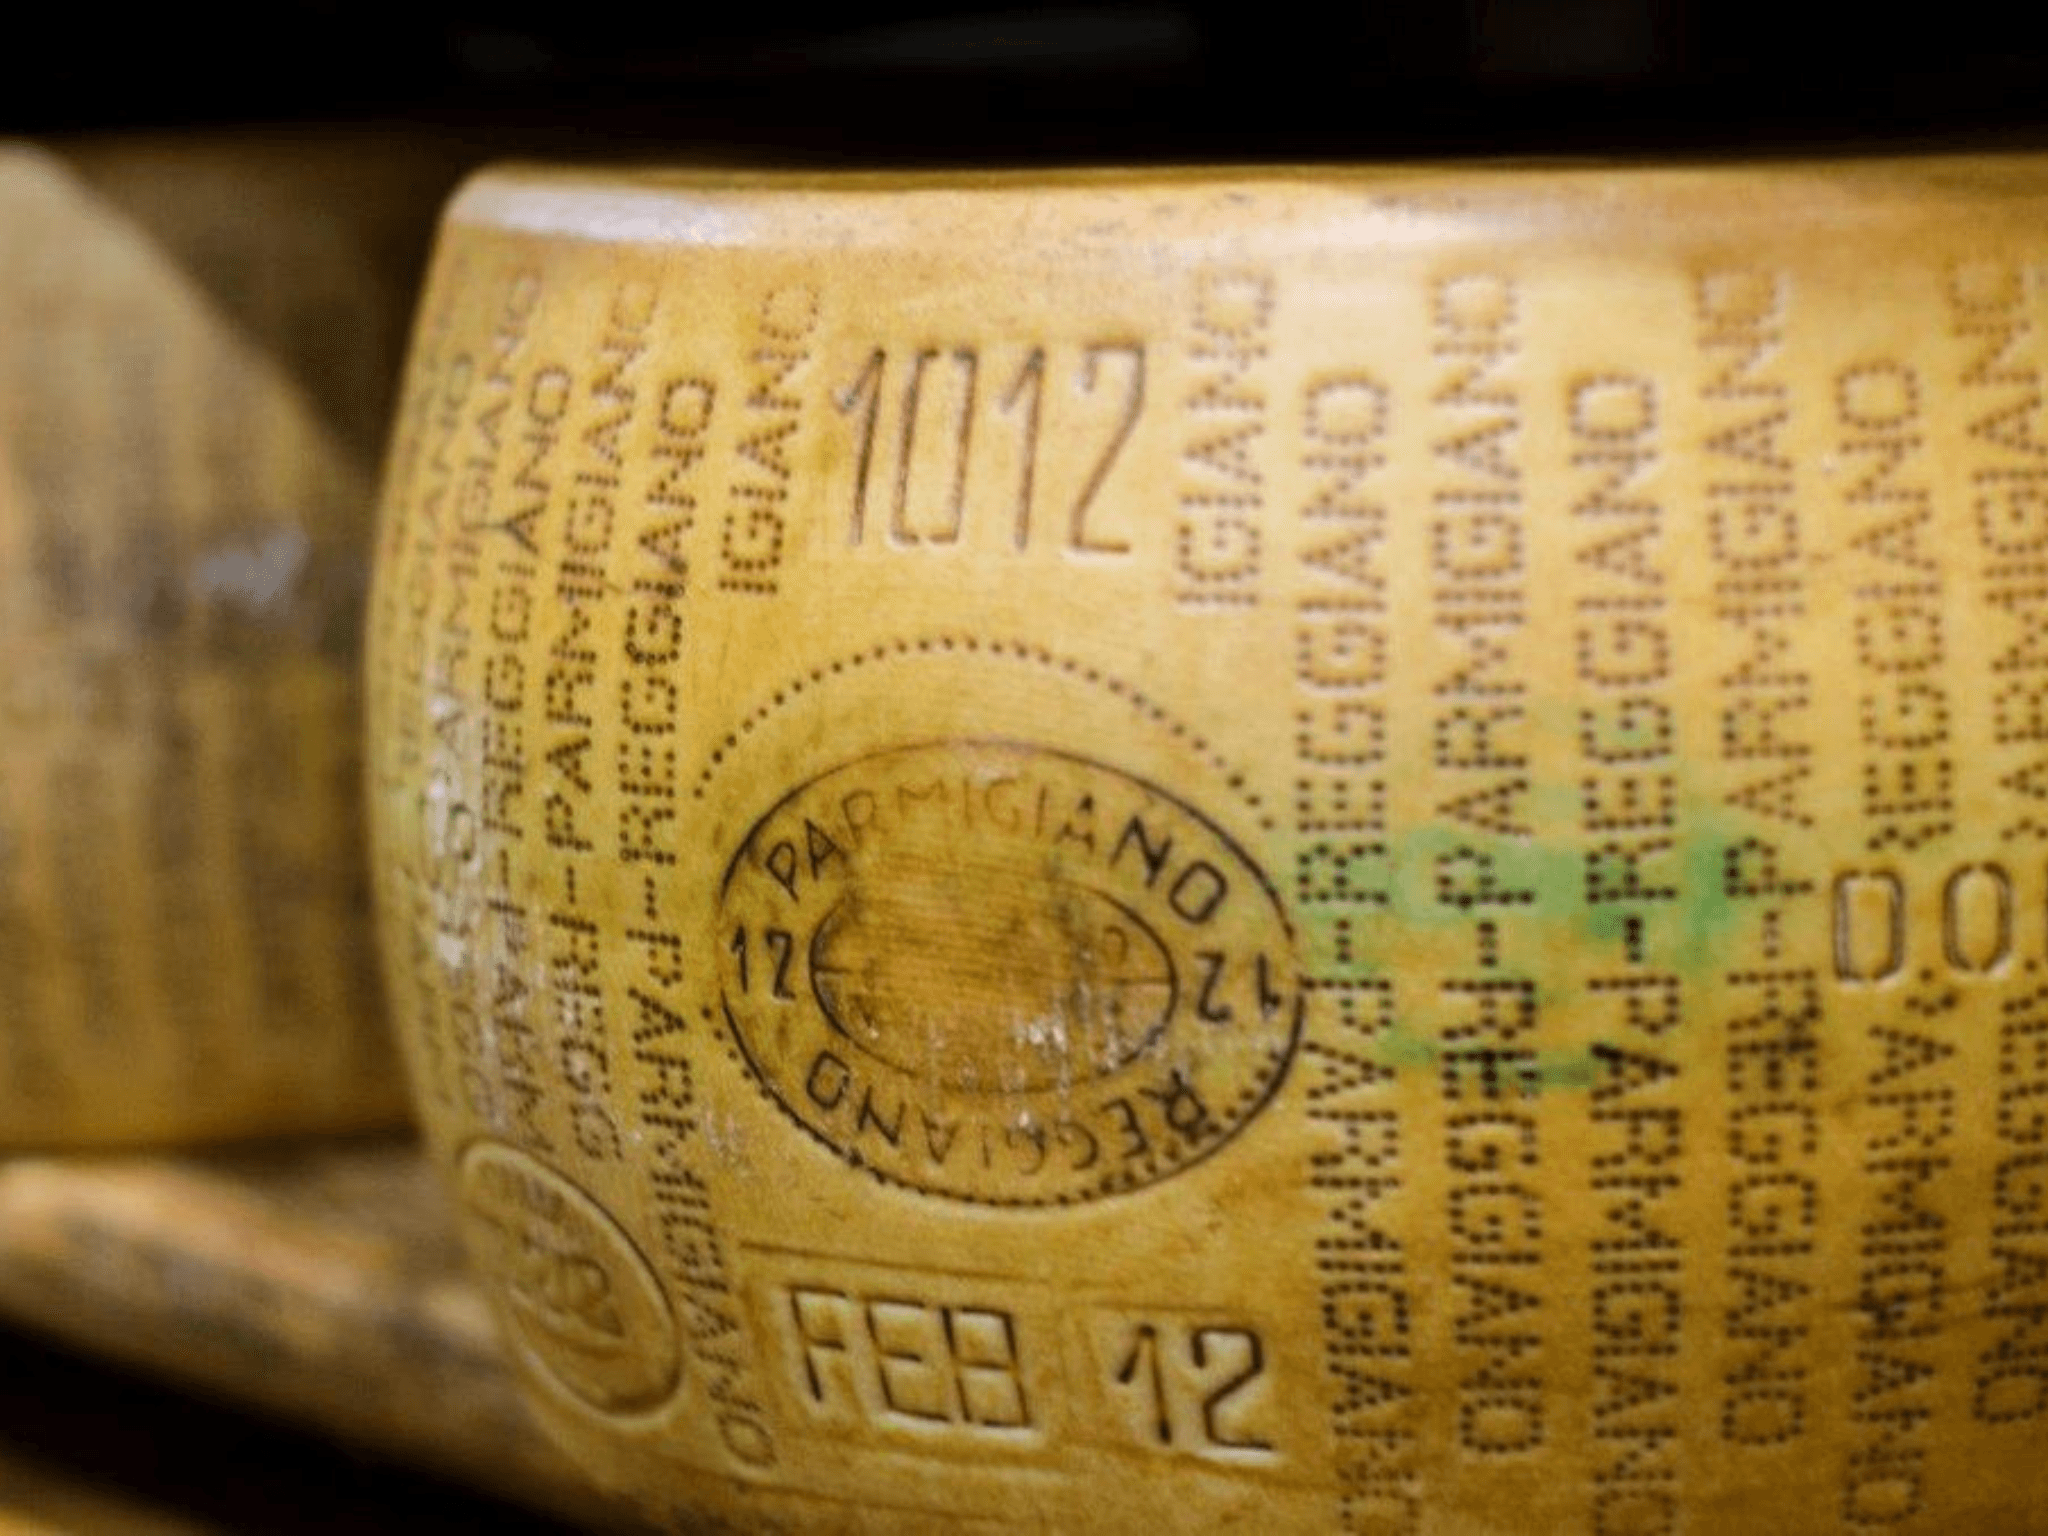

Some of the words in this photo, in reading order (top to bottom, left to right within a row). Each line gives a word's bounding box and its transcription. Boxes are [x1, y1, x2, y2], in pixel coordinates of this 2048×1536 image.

[482, 364, 572, 840] REGGIANO
[545, 276, 660, 853] PARMIGIANO
[618, 376, 717, 866] REGGIANO
[834, 341, 1146, 554] 1012
[1296, 368, 1390, 906] REGGIANO
[1430, 262, 1536, 907] PARMIGIANO
[1566, 370, 1682, 906] REGGIANO
[1694, 258, 1816, 900] PARMIGIANO
[732, 922, 797, 1001] 12
[1194, 948, 1284, 1024] 12
[1832, 860, 2048, 985] 00
[624, 926, 778, 1470] PARMIGIANO
[790, 1284, 1034, 1430] FEB
[1114, 1320, 1274, 1452] 12
[1300, 976, 1422, 1536] PARMIGIANO
[1440, 978, 1544, 1456] REGGIANO
[1586, 974, 1684, 1536] PARMIGIANO
[1720, 970, 1822, 1446] REGGIANO
